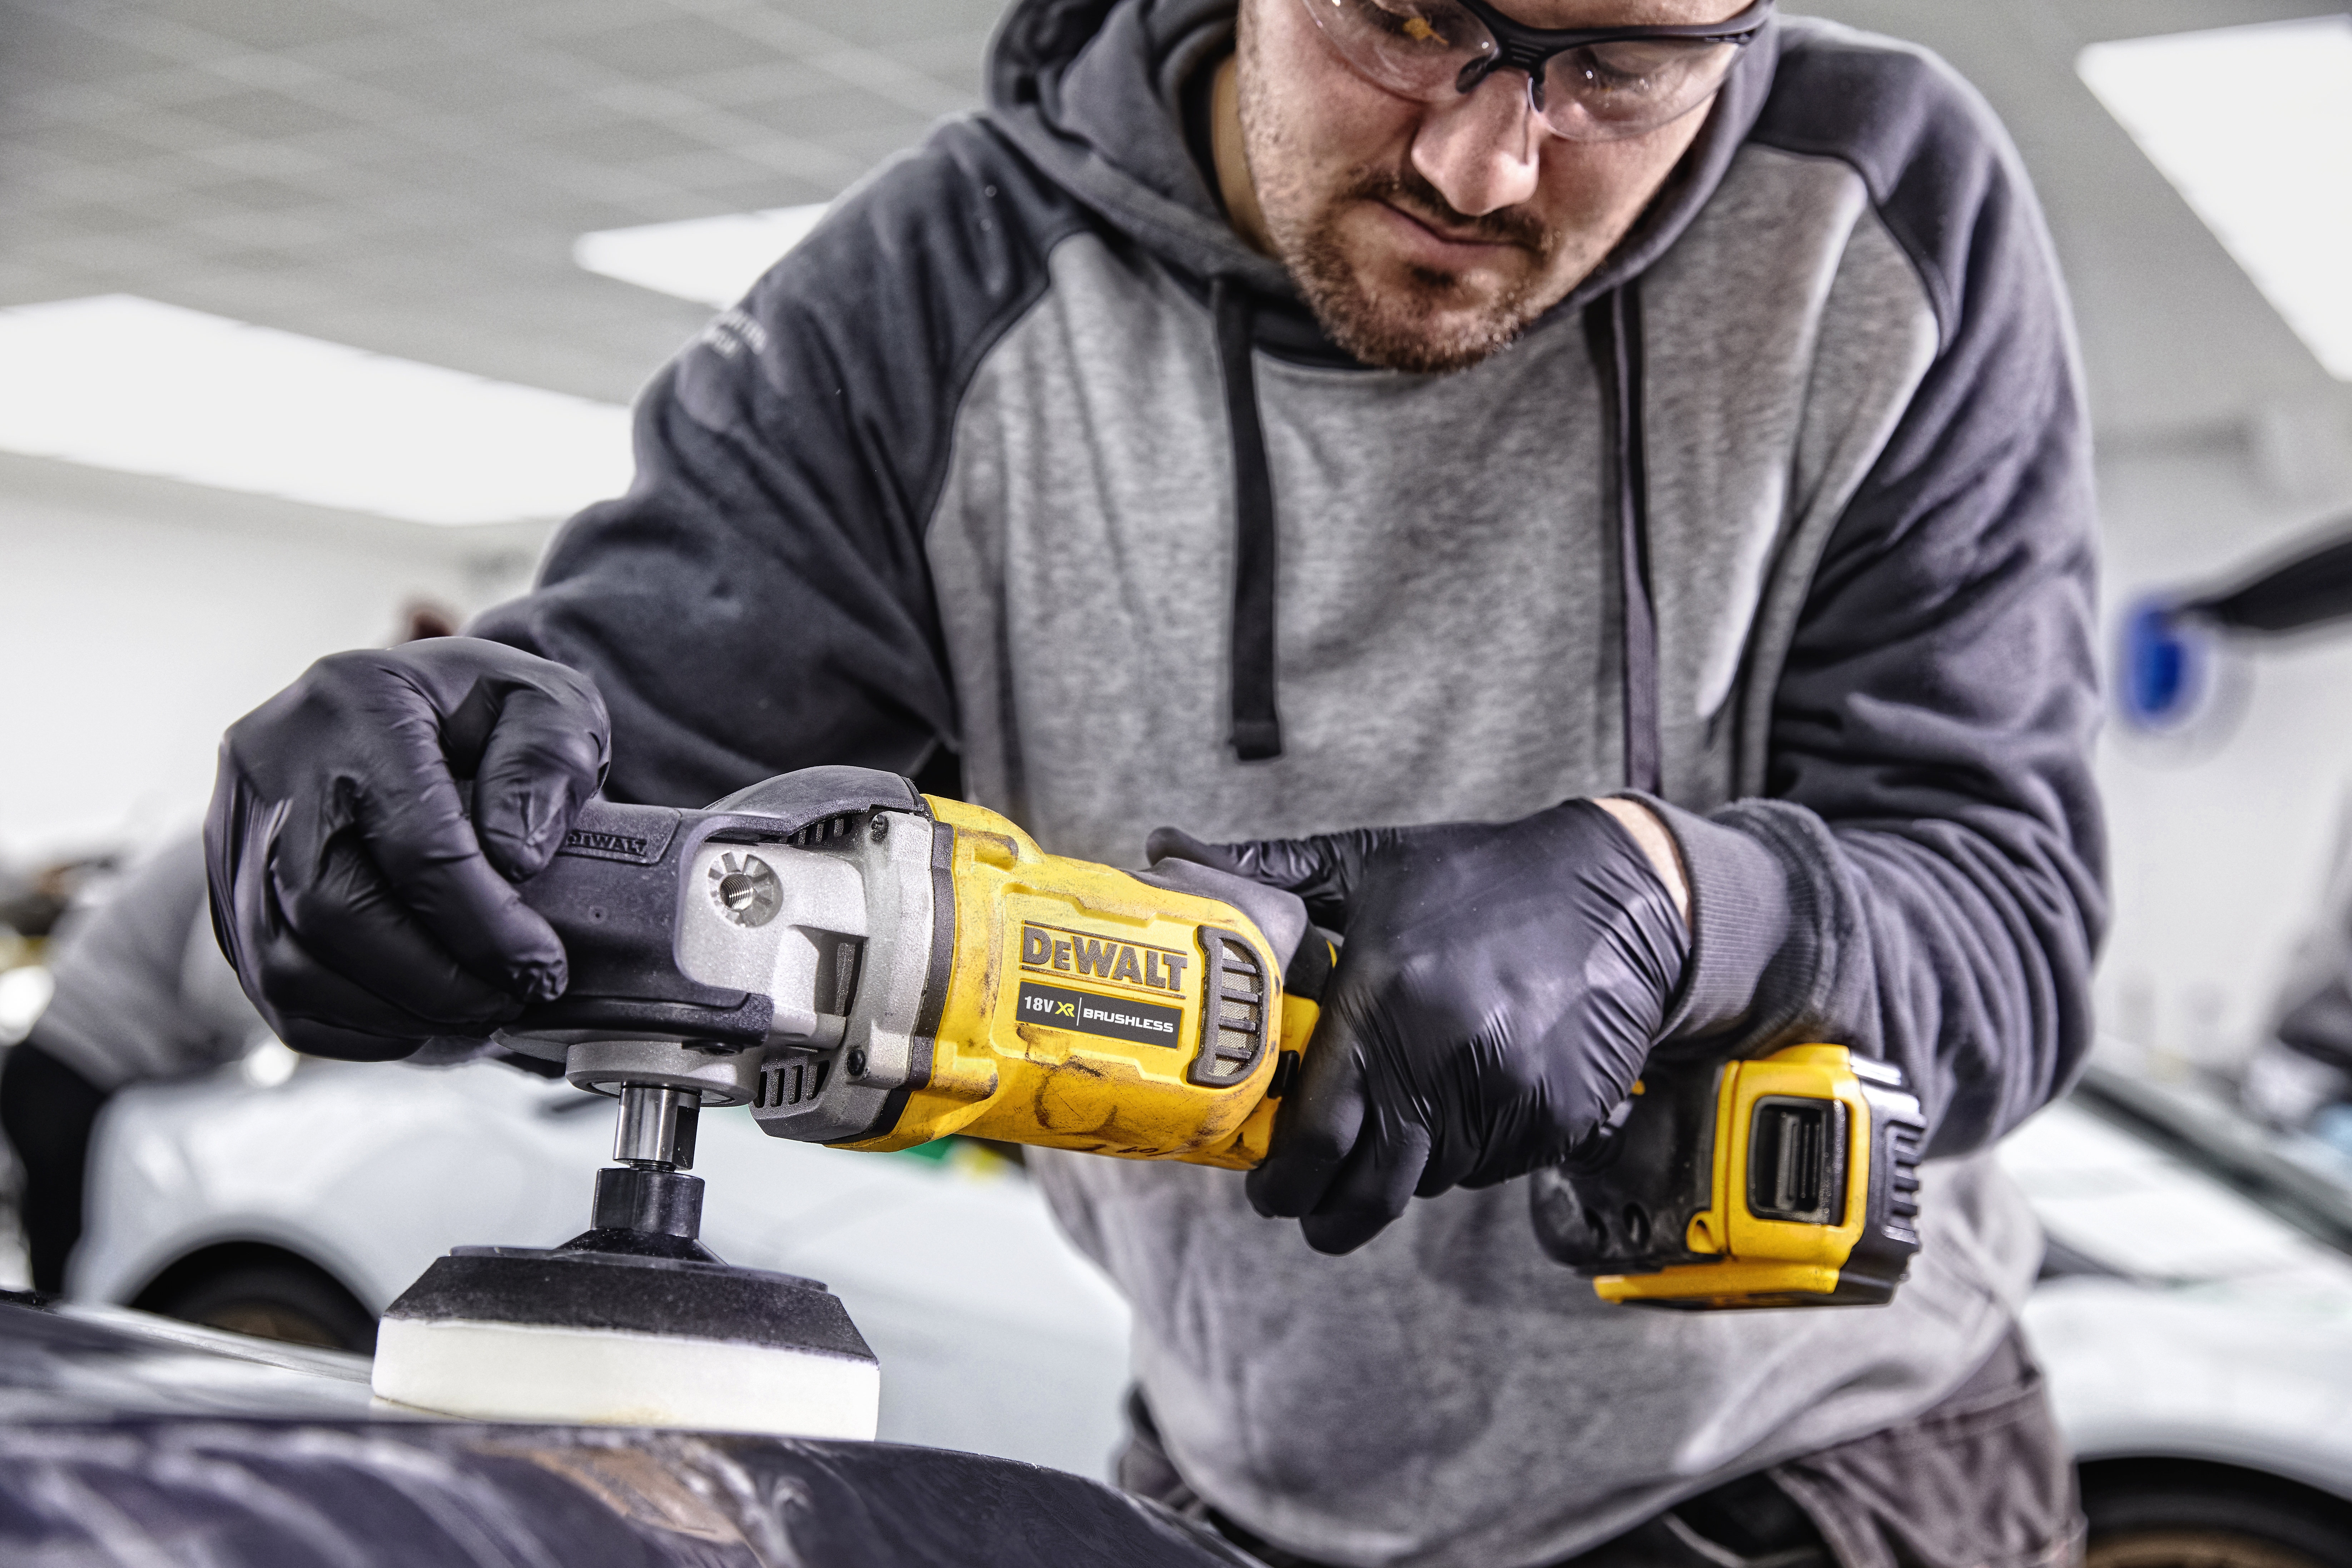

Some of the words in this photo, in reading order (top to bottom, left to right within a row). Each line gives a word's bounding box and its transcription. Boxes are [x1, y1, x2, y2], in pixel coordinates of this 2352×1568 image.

[1022, 926, 1188, 992] DEWALT
[1024, 996, 1054, 1013] 18V
[1055, 1001, 1075, 1017] XR
[1083, 1008, 1173, 1033] BRUSHLESS
